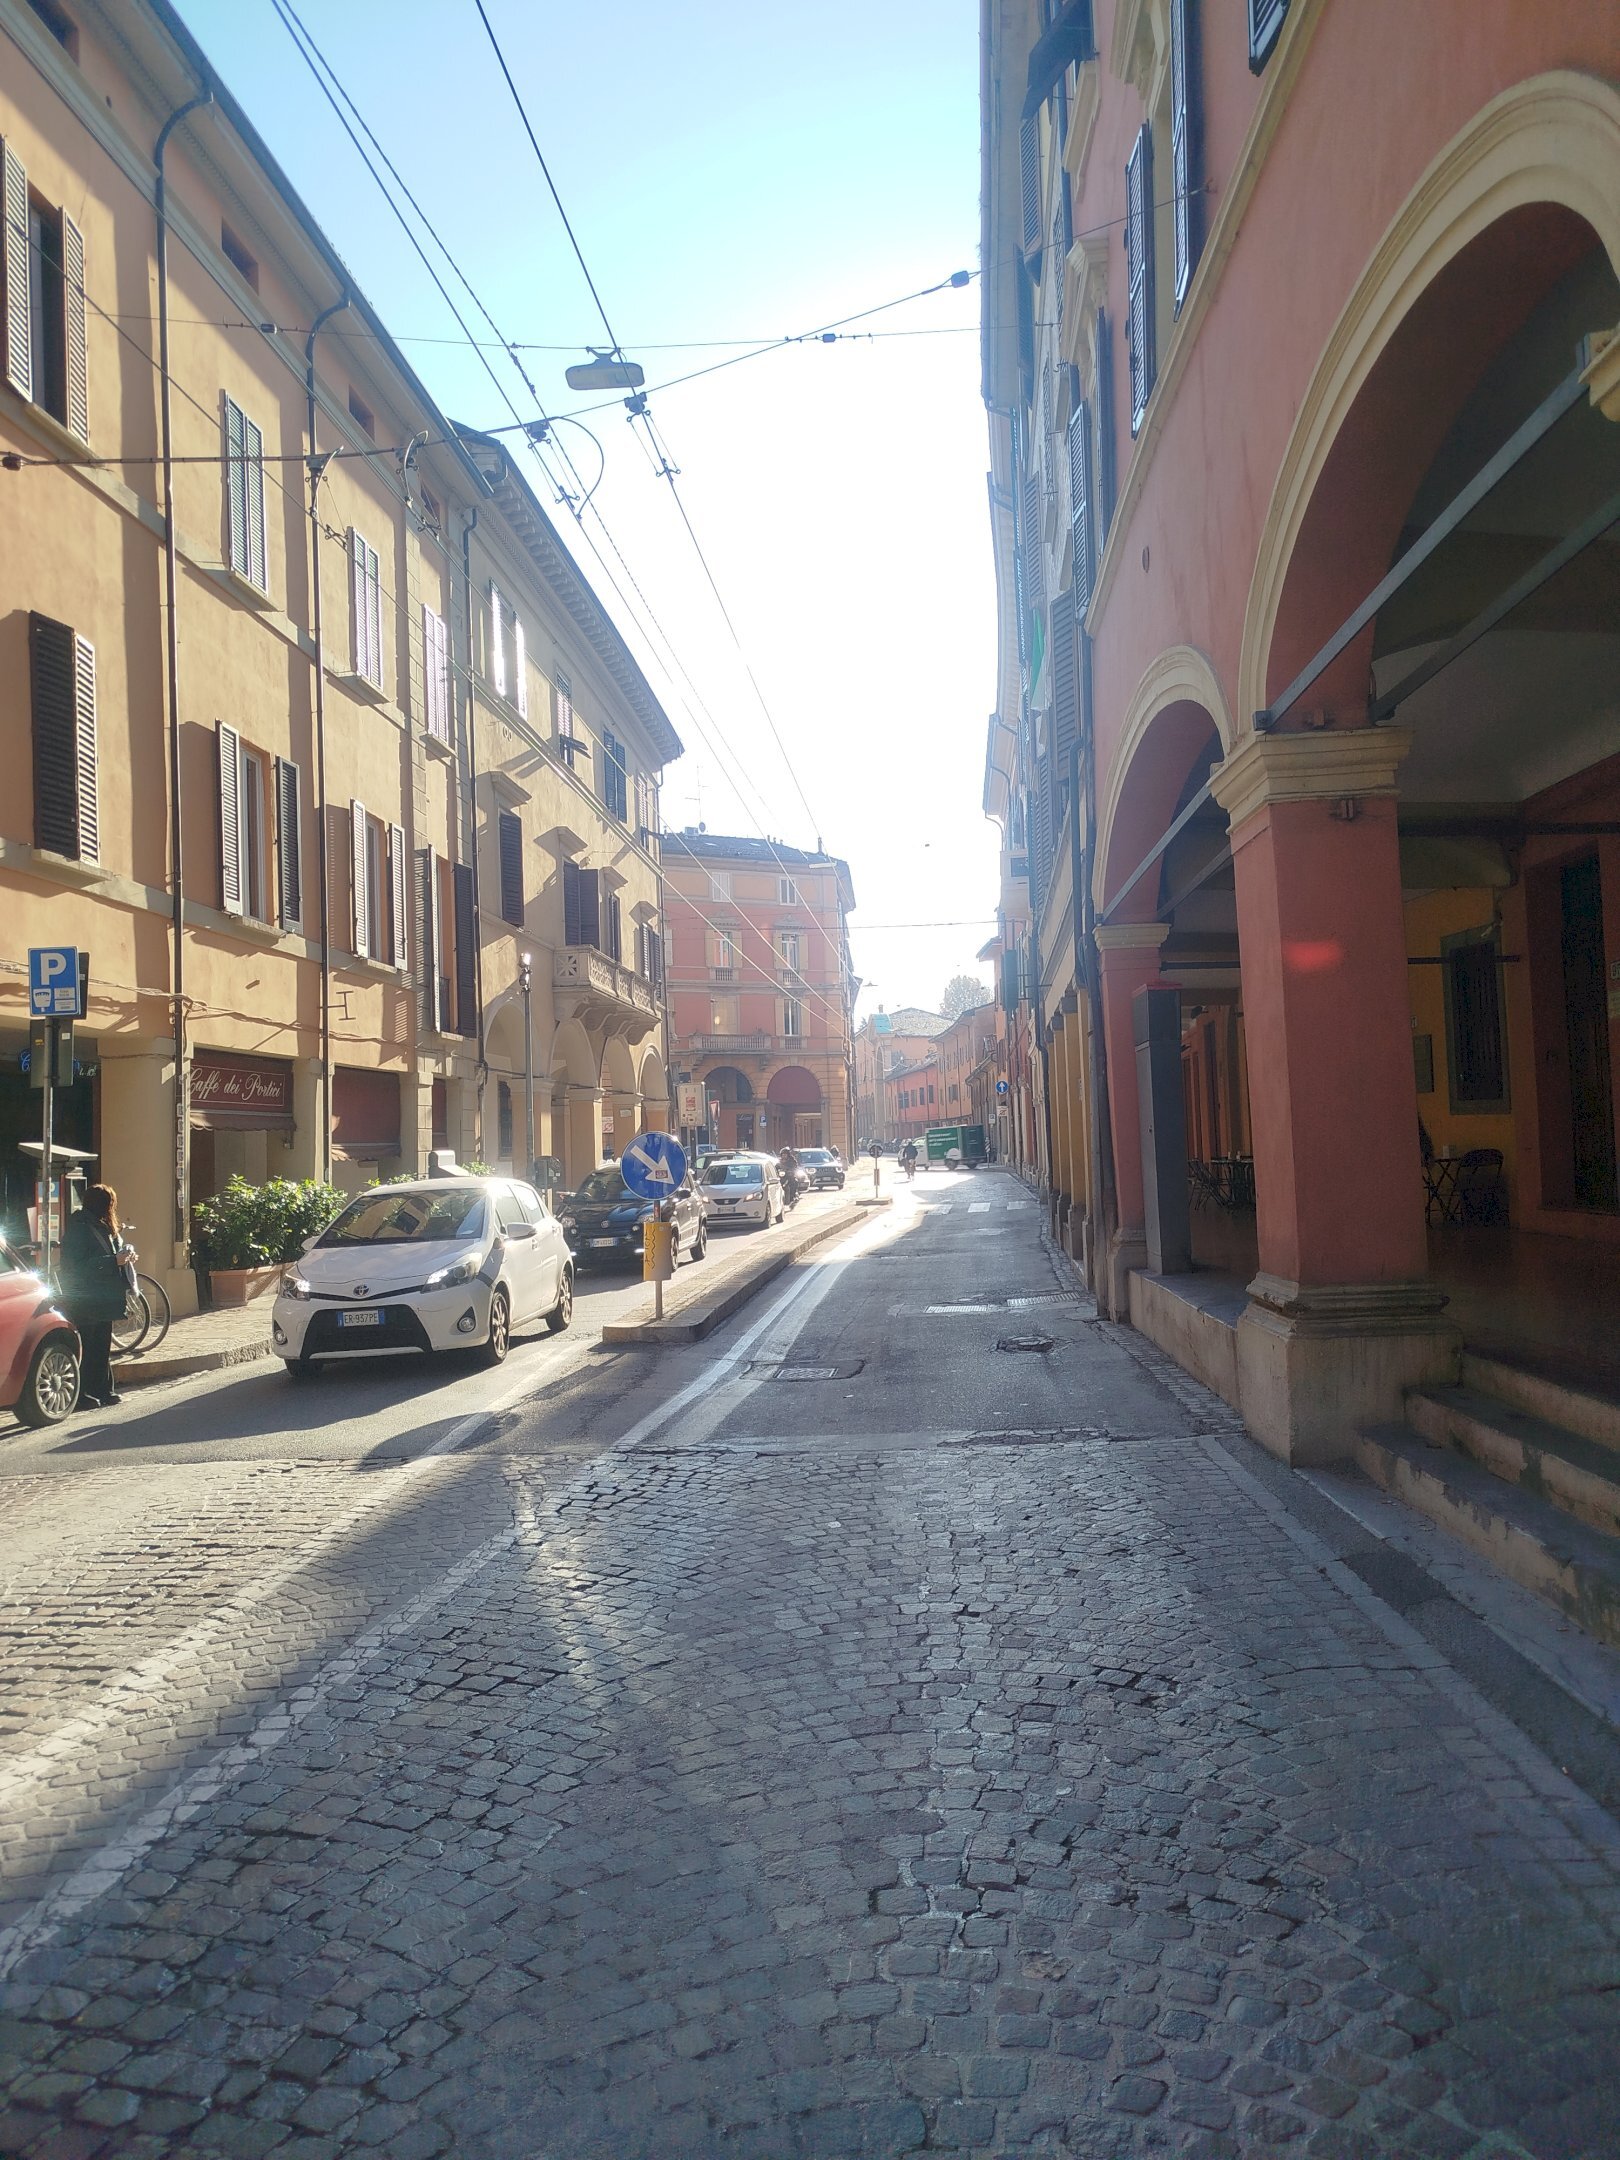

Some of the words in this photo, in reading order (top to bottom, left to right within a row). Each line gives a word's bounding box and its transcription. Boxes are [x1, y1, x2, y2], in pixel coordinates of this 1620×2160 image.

[40, 952, 67, 986] P
[224, 1075, 242, 1095] dei
[241, 1073, 283, 1101] Portici
